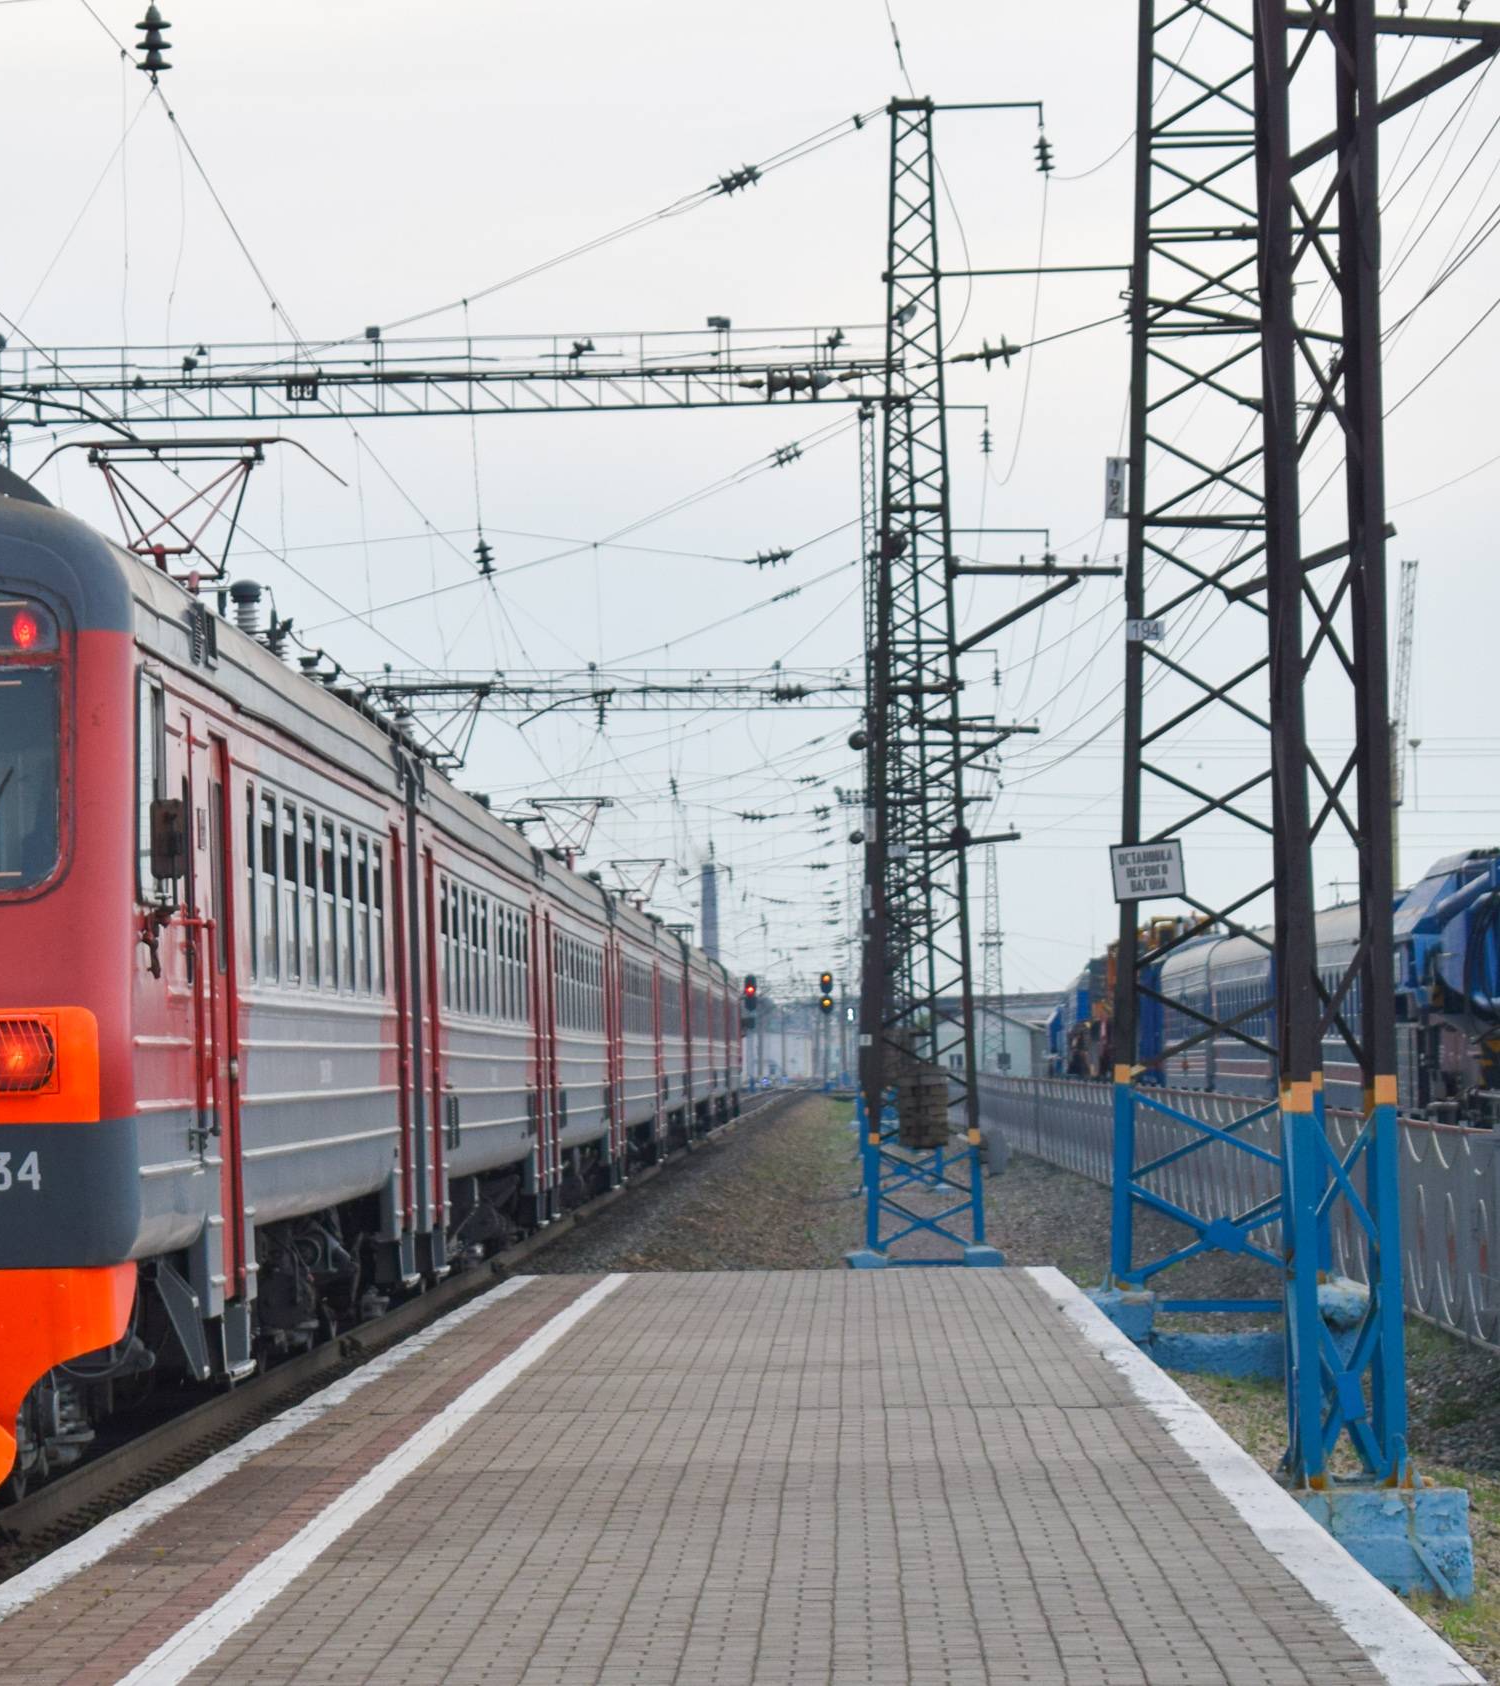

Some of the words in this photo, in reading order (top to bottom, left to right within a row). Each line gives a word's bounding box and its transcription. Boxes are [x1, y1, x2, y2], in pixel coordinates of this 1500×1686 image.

[1131, 622, 1160, 640] 194
[1118, 848, 1172, 865] ОСТАНОВКА
[1126, 864, 1168, 878] ПЕРВОГО
[1130, 877, 1168, 892] ВАГОНА
